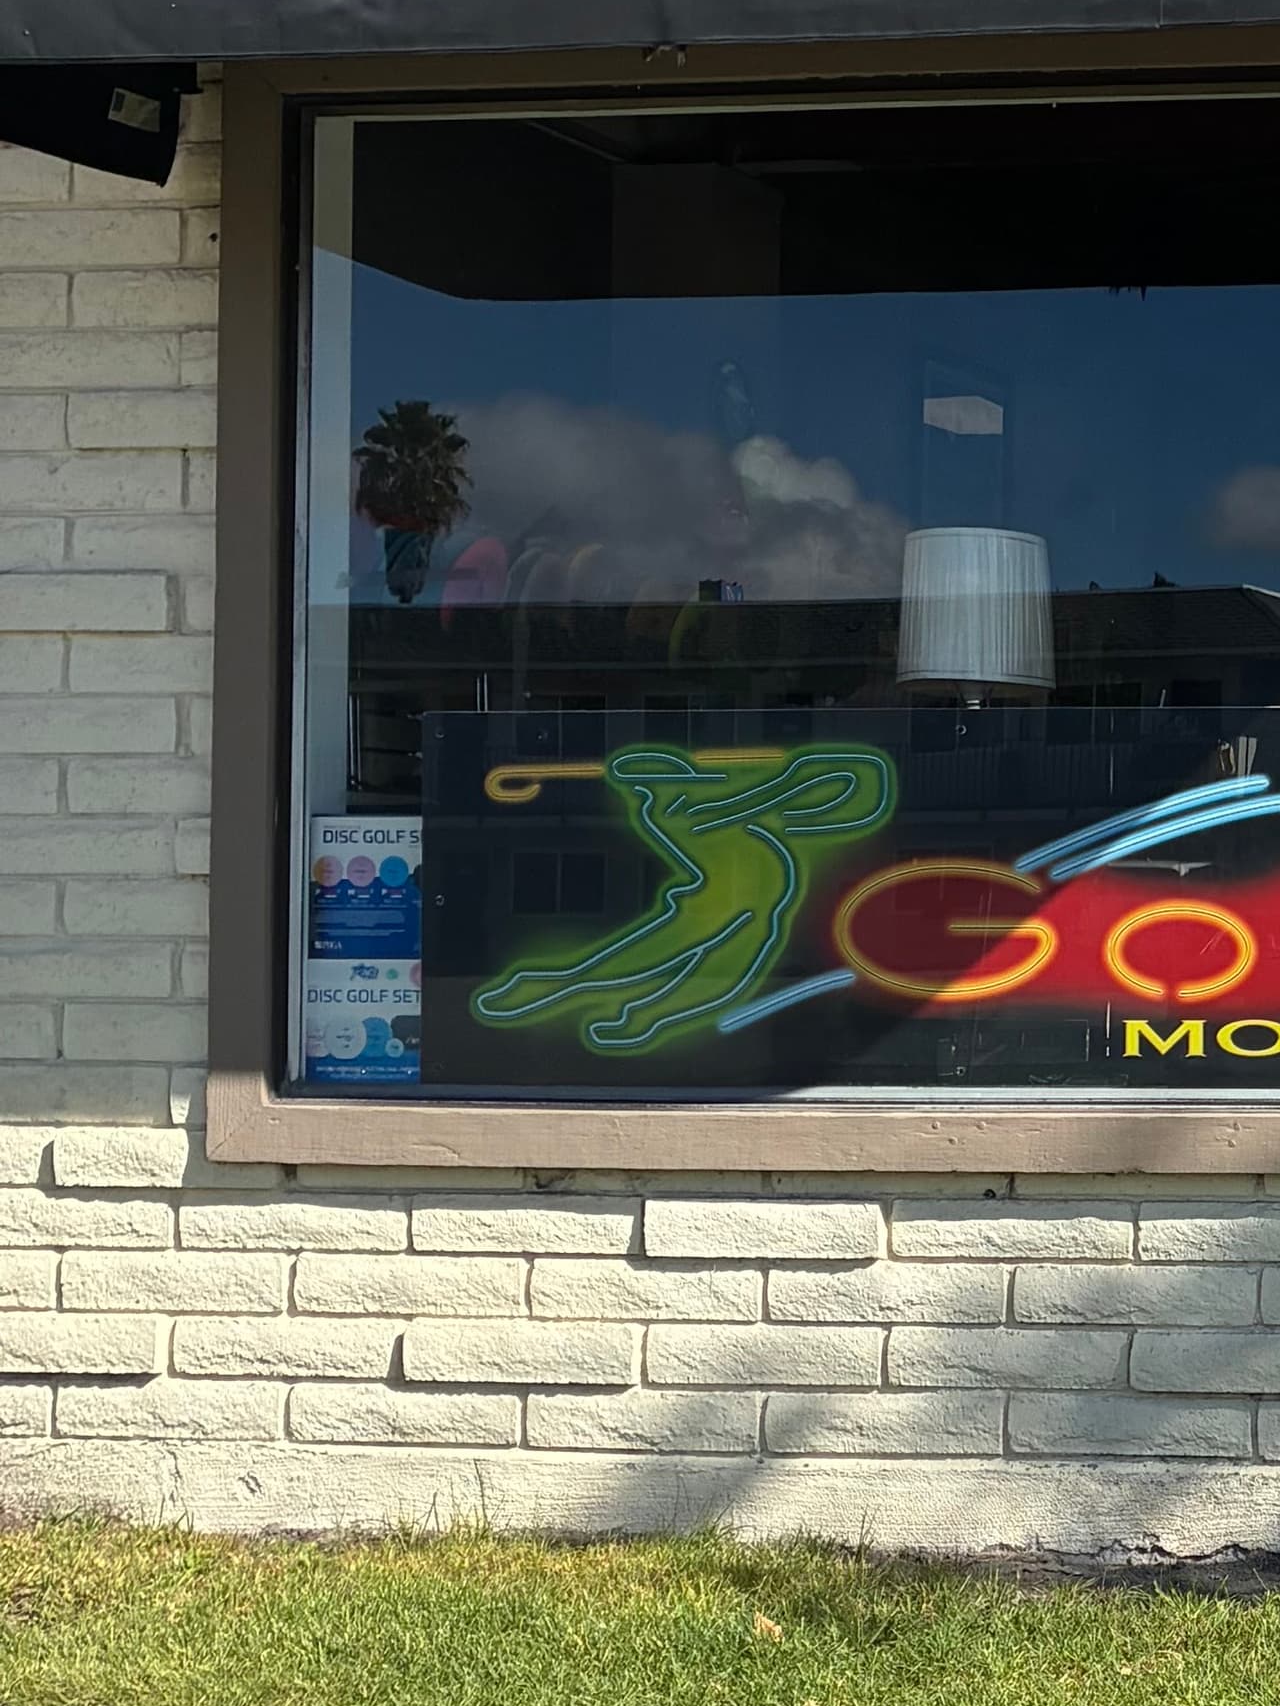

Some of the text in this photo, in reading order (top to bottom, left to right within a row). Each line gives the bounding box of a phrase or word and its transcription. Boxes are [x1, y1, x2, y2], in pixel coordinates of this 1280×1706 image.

[322, 830, 359, 844] DISC
[362, 829, 407, 844] GOLF
[307, 989, 420, 1004] DISC GOLF SET
